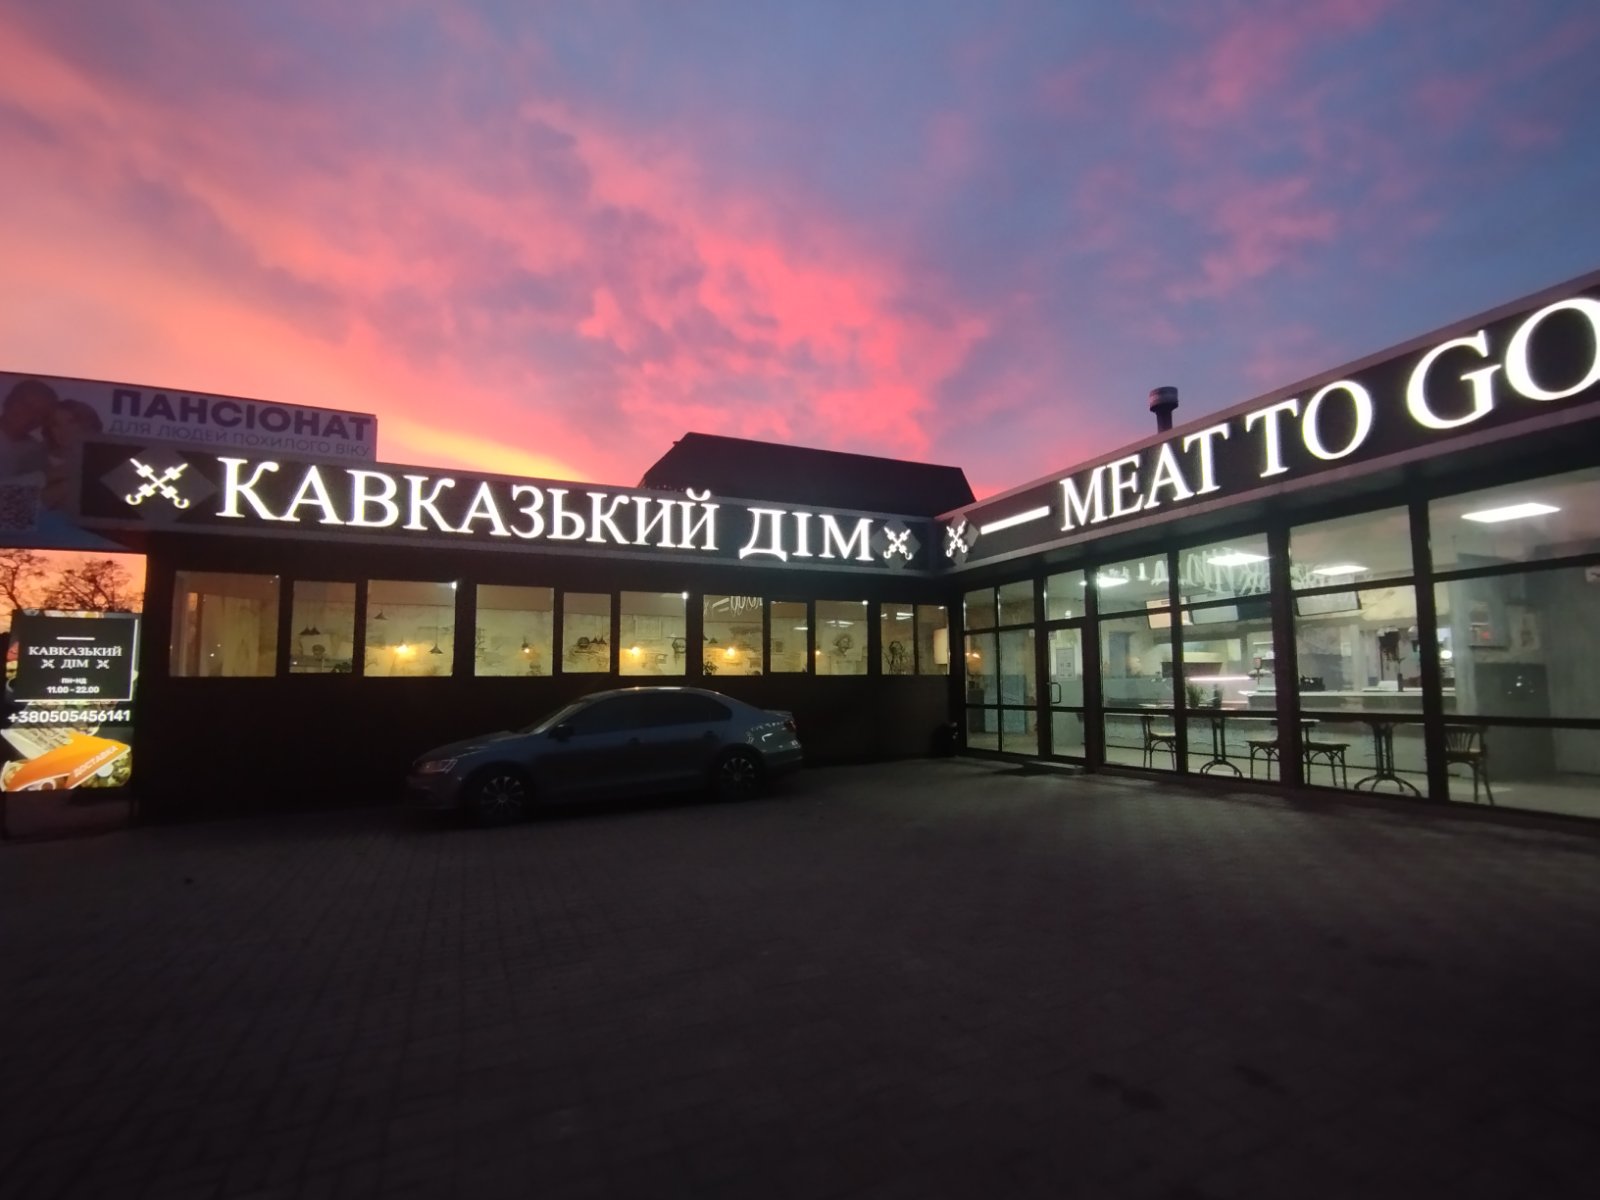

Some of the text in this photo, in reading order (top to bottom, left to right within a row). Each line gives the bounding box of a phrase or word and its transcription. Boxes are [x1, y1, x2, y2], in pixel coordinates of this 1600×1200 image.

[111, 388, 371, 441] ПАНСІОНАТ
[1059, 297, 1600, 533] MEAT TO GO
[109, 419, 370, 457] ДЛЯ ЛЮДЕЙ ПОХИЛОГО ВІКУ
[215, 456, 875, 562] КАВКАЗЬКИЙ ДІМ
[28, 646, 122, 657] КАВКАЗЬКИЙ
[60, 659, 89, 669] ДІМ
[46, 686, 69, 694] 11.00
[75, 686, 100, 694] 22.00
[8, 709, 131, 723] +380505456141
